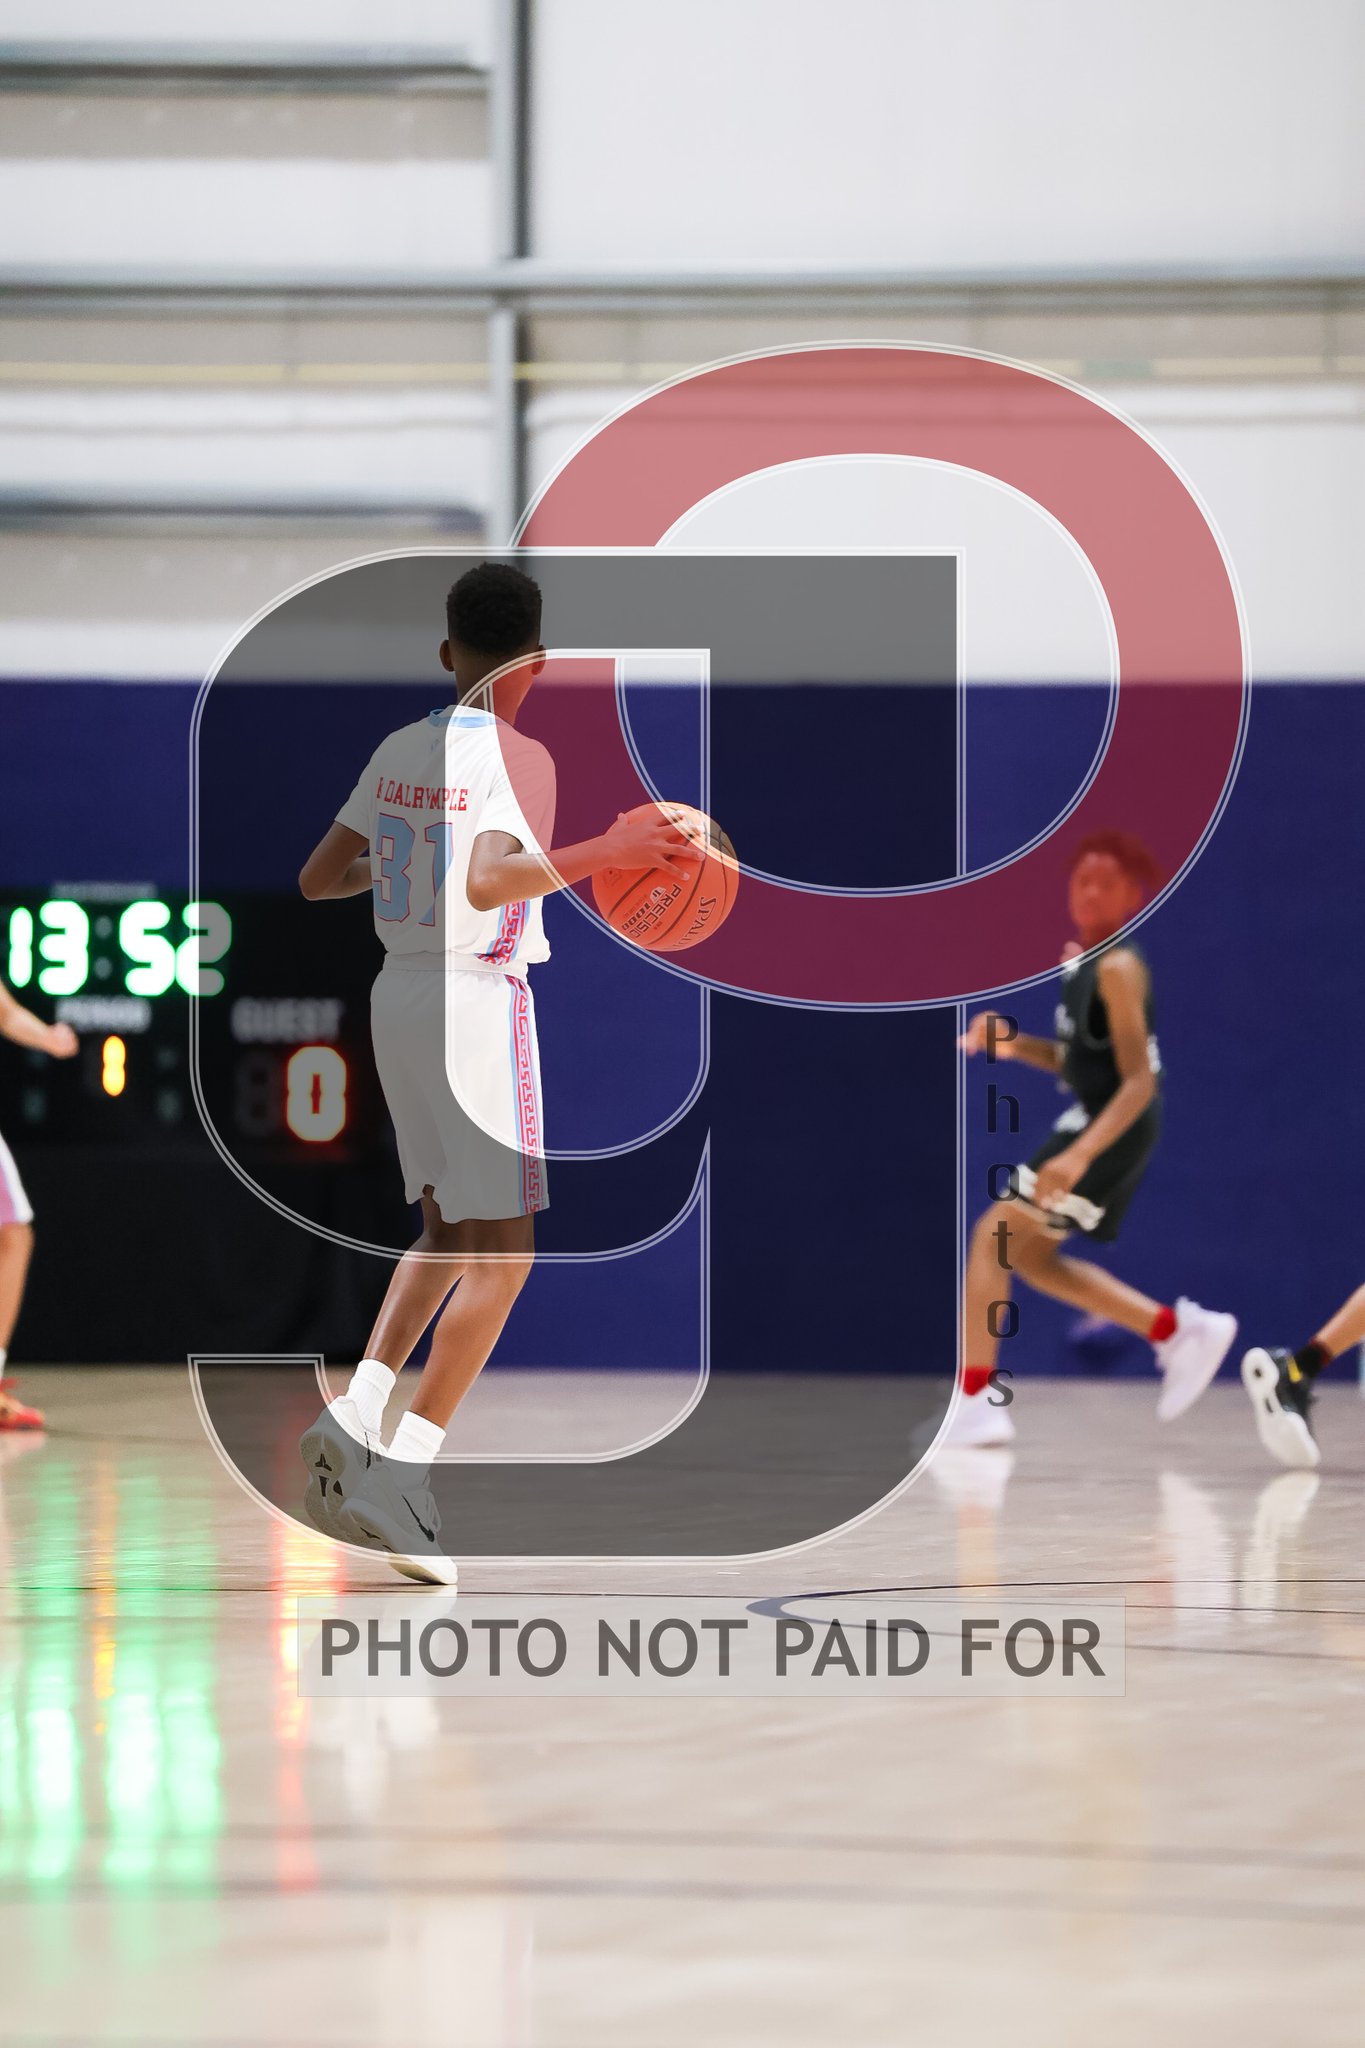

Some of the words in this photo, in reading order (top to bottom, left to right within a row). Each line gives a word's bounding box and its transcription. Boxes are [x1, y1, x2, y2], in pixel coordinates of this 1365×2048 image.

[383, 780, 469, 811] DALRYMPLE
[372, 812, 454, 927] 31
[102, 1035, 126, 1096] 1
[286, 1045, 347, 1142] 0
